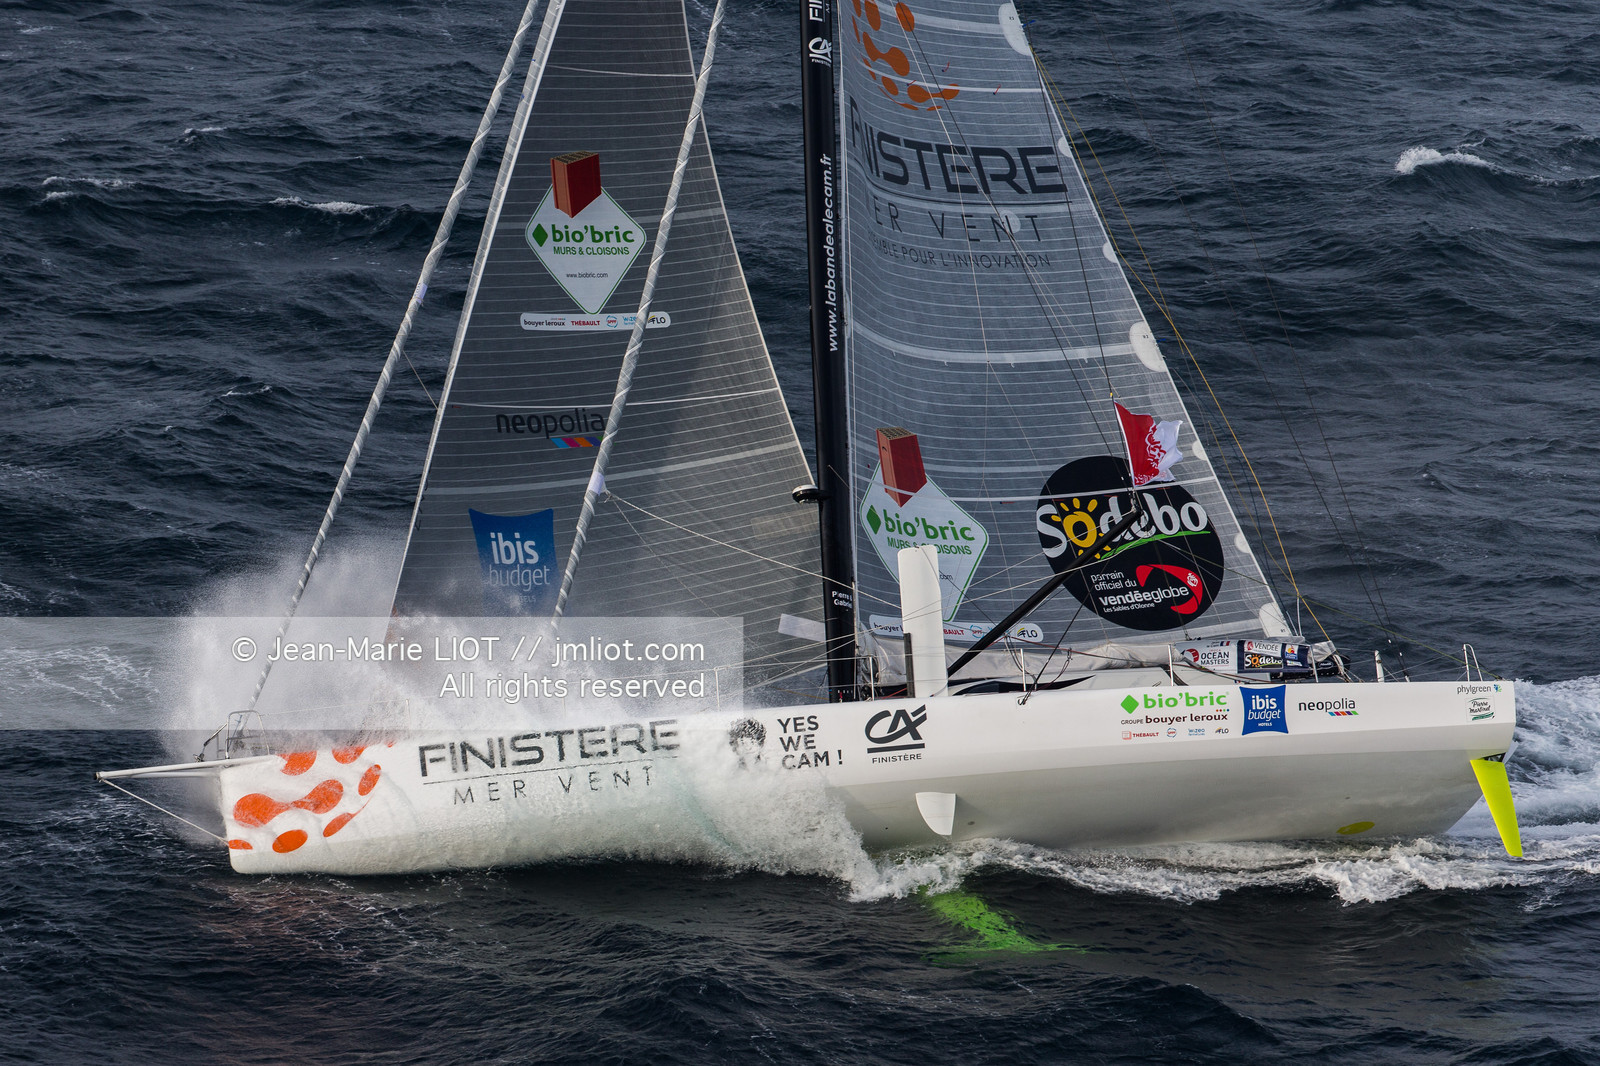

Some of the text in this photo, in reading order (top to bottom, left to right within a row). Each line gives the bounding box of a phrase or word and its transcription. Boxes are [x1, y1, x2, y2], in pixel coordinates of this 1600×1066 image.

[551, 224, 635, 243] bio'bric
[928, 211, 1041, 243] VENT
[553, 247, 630, 255] MURS & CLOISONS
[820, 153, 838, 352] www.labandealecam.fr
[901, 246, 936, 265] POUR
[495, 408, 606, 439] neopolia
[883, 509, 975, 541] bio'bric
[490, 532, 539, 564] ibis
[489, 565, 550, 592] budget
[1091, 571, 1124, 583] parrain
[1094, 579, 1137, 591] officiel du
[1456, 685, 1492, 694] phylgreen
[1143, 691, 1228, 709] bio'bric
[1251, 695, 1277, 710] ibis
[1298, 698, 1356, 712] neopolia
[777, 715, 819, 733] YES
[1145, 715, 1187, 725] bouyer
[1189, 713, 1228, 722] leroux
[1247, 709, 1281, 721] budget
[418, 719, 680, 777] FINISTERE
[779, 734, 816, 752] WE
[782, 750, 830, 770] CAM
[872, 753, 922, 764] FINISTÈRE
[453, 765, 654, 805] MER VENT
